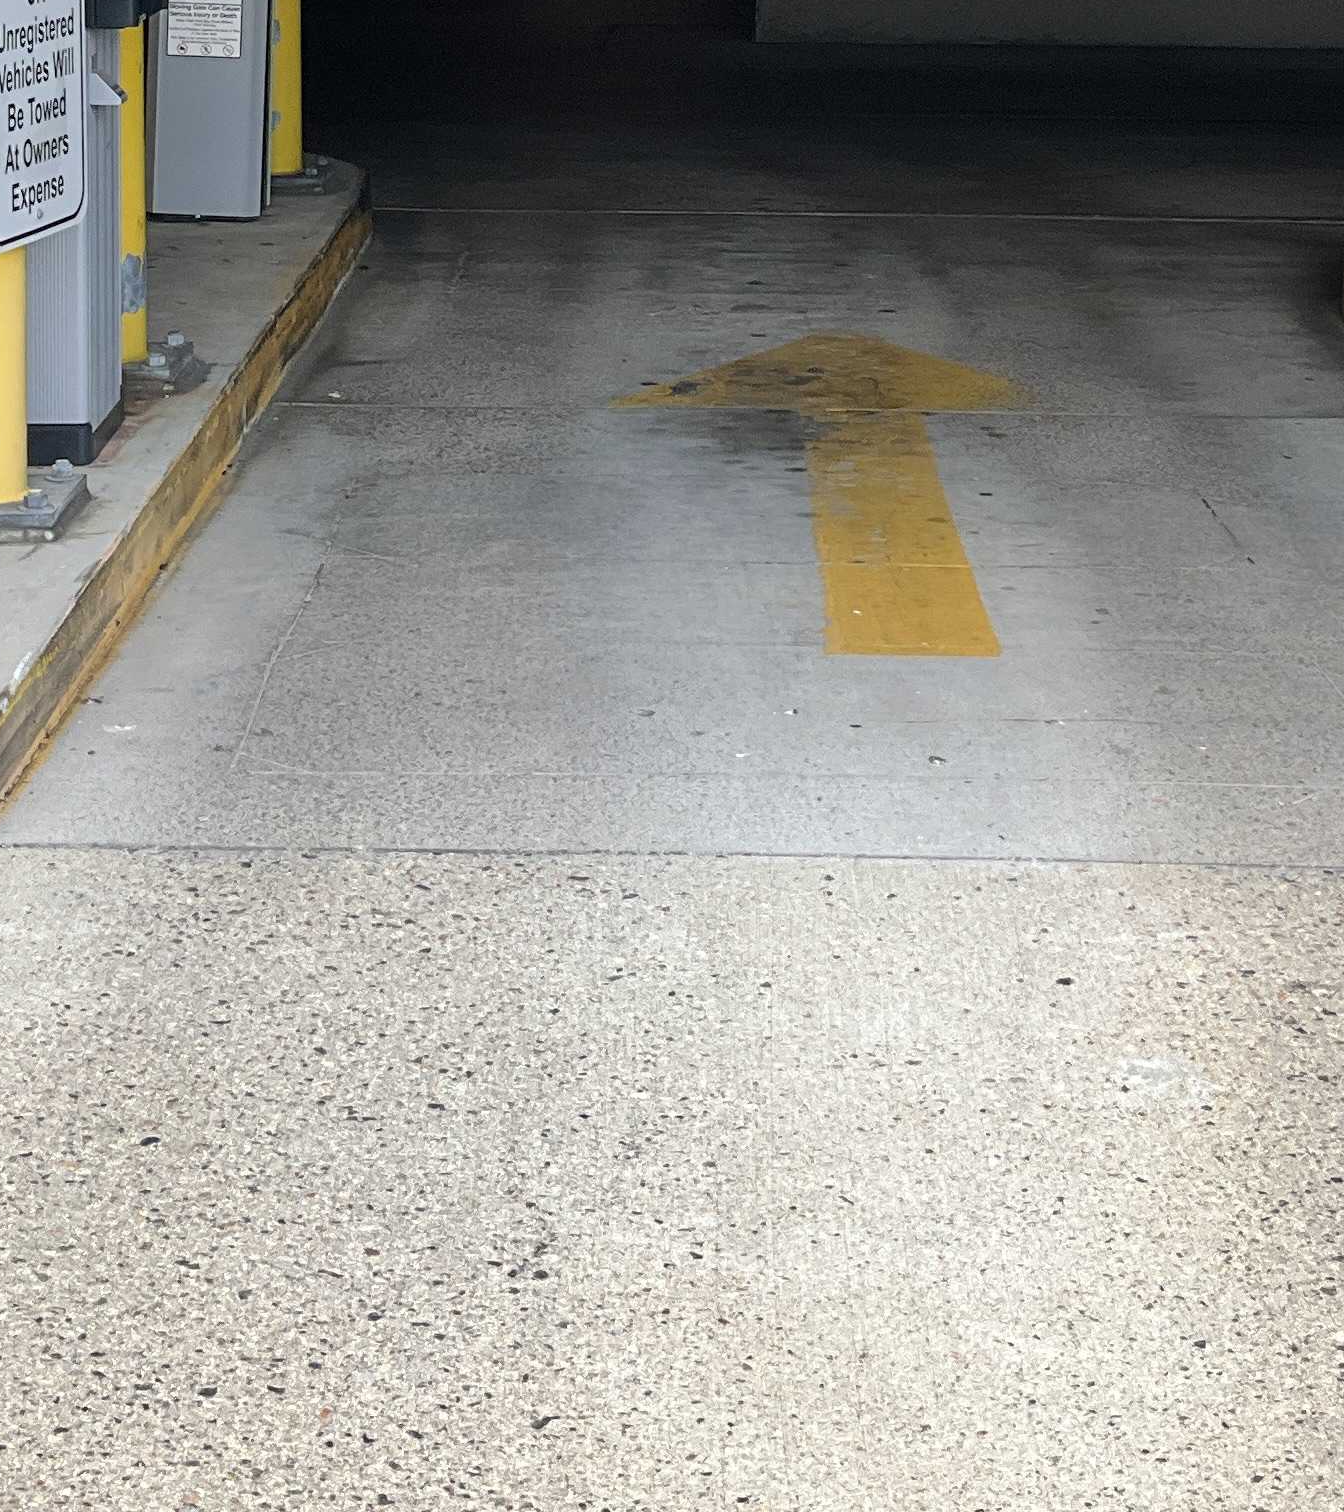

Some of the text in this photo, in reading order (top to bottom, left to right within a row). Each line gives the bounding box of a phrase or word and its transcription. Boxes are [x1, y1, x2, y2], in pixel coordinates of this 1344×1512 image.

[53, 47, 74, 77] Will
[8, 89, 67, 131] Be Towed
[5, 131, 69, 174] At Owners
[11, 174, 64, 213] Expense
